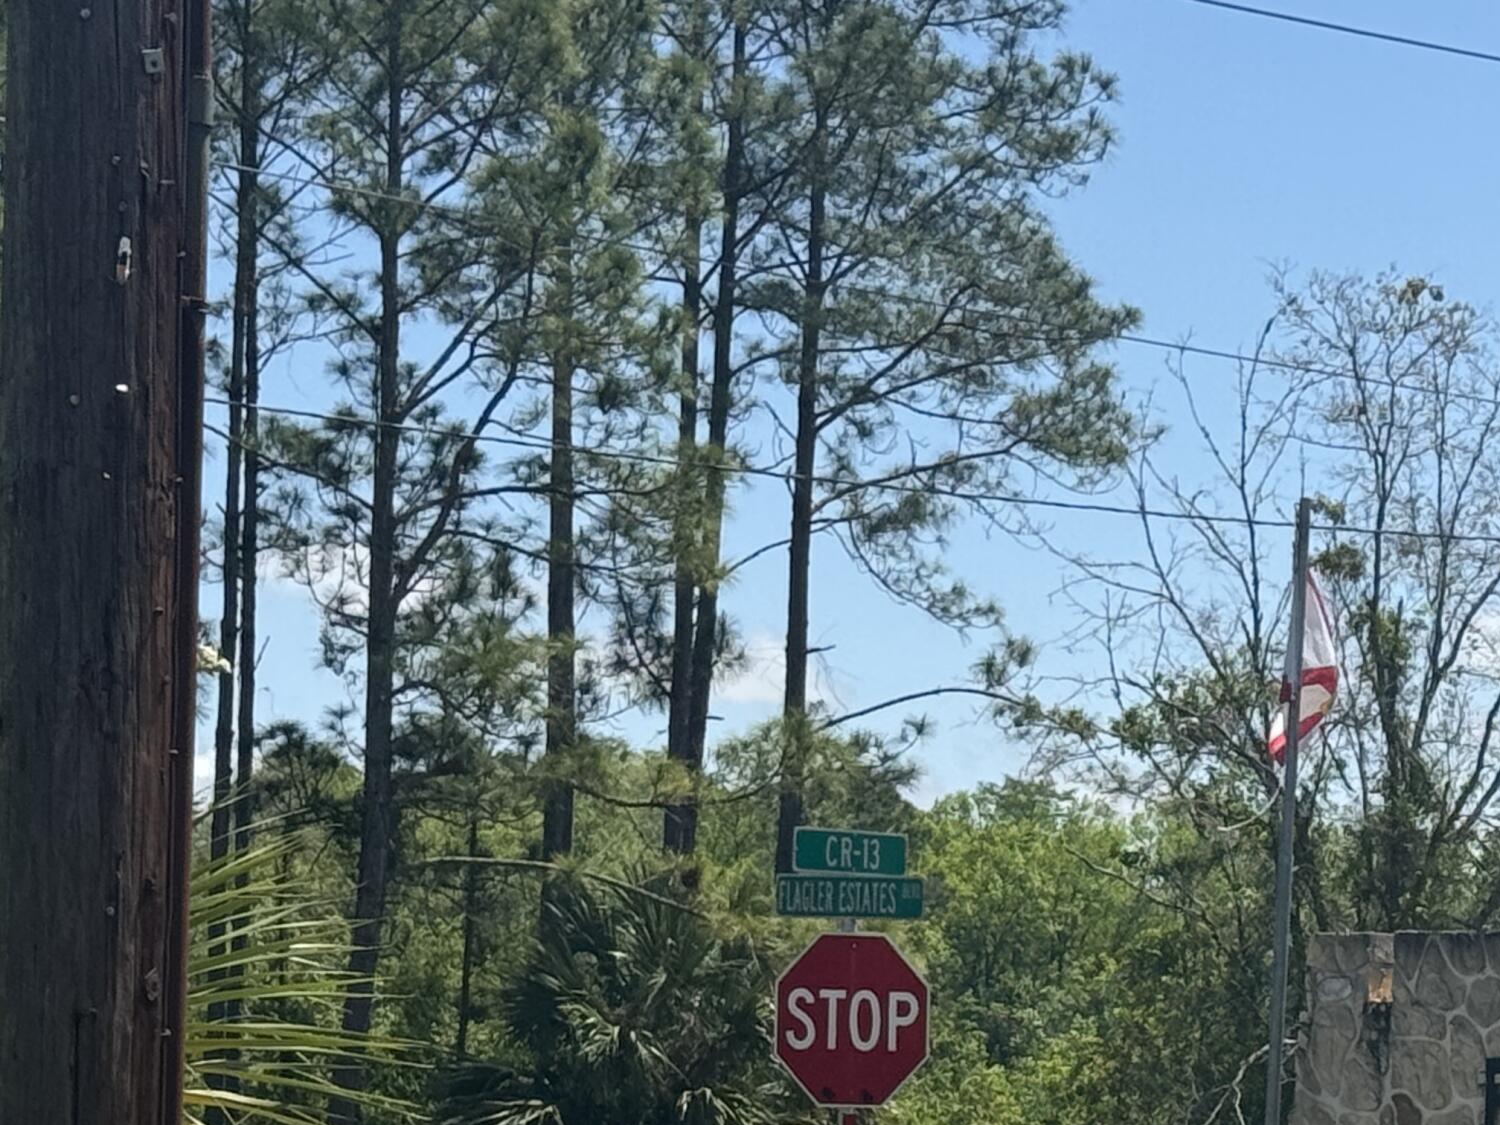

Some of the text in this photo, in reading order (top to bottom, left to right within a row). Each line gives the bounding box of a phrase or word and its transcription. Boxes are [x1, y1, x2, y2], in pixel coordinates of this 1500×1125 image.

[825, 835, 880, 870] CR-13
[778, 880, 834, 913] FLAGLER
[839, 881, 897, 913] ESTATES
[785, 987, 920, 1052] STOP
